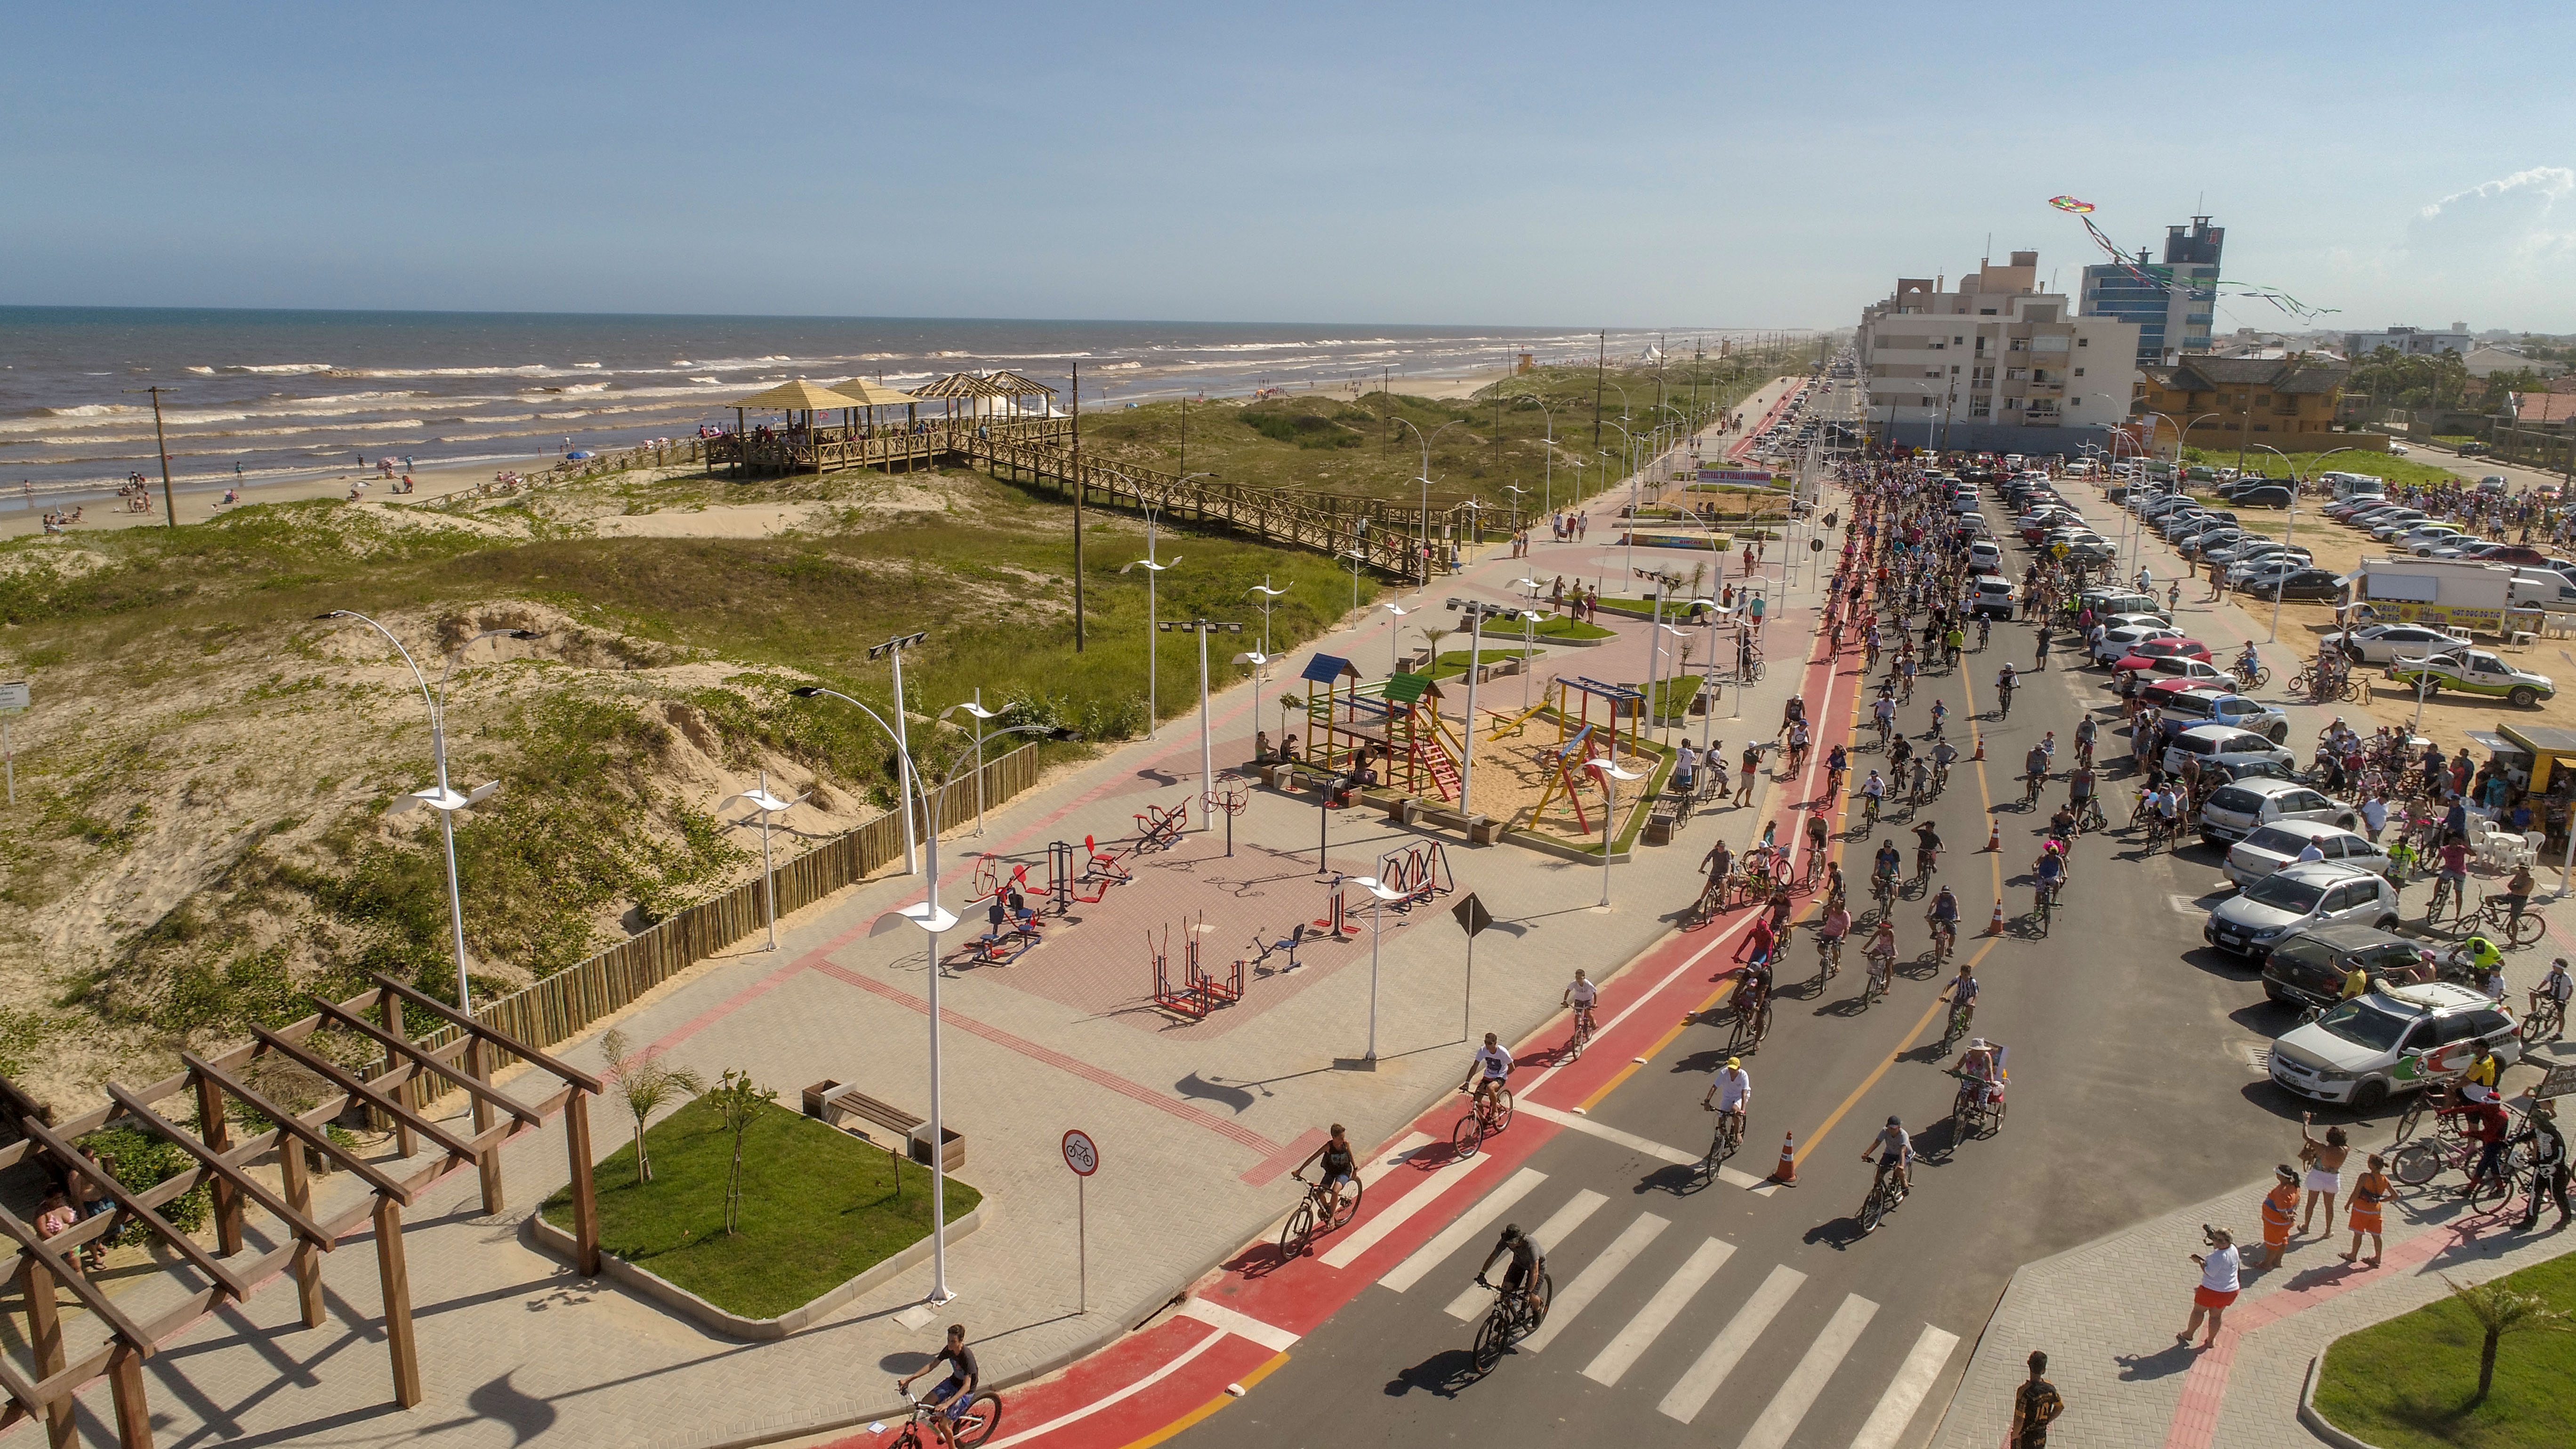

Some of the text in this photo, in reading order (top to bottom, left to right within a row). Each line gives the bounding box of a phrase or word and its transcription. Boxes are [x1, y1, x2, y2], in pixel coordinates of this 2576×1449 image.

[2144, 426, 2153, 435] 25
[1699, 471, 1718, 479] FESTIVAL
[1680, 754, 1684, 763] 7
